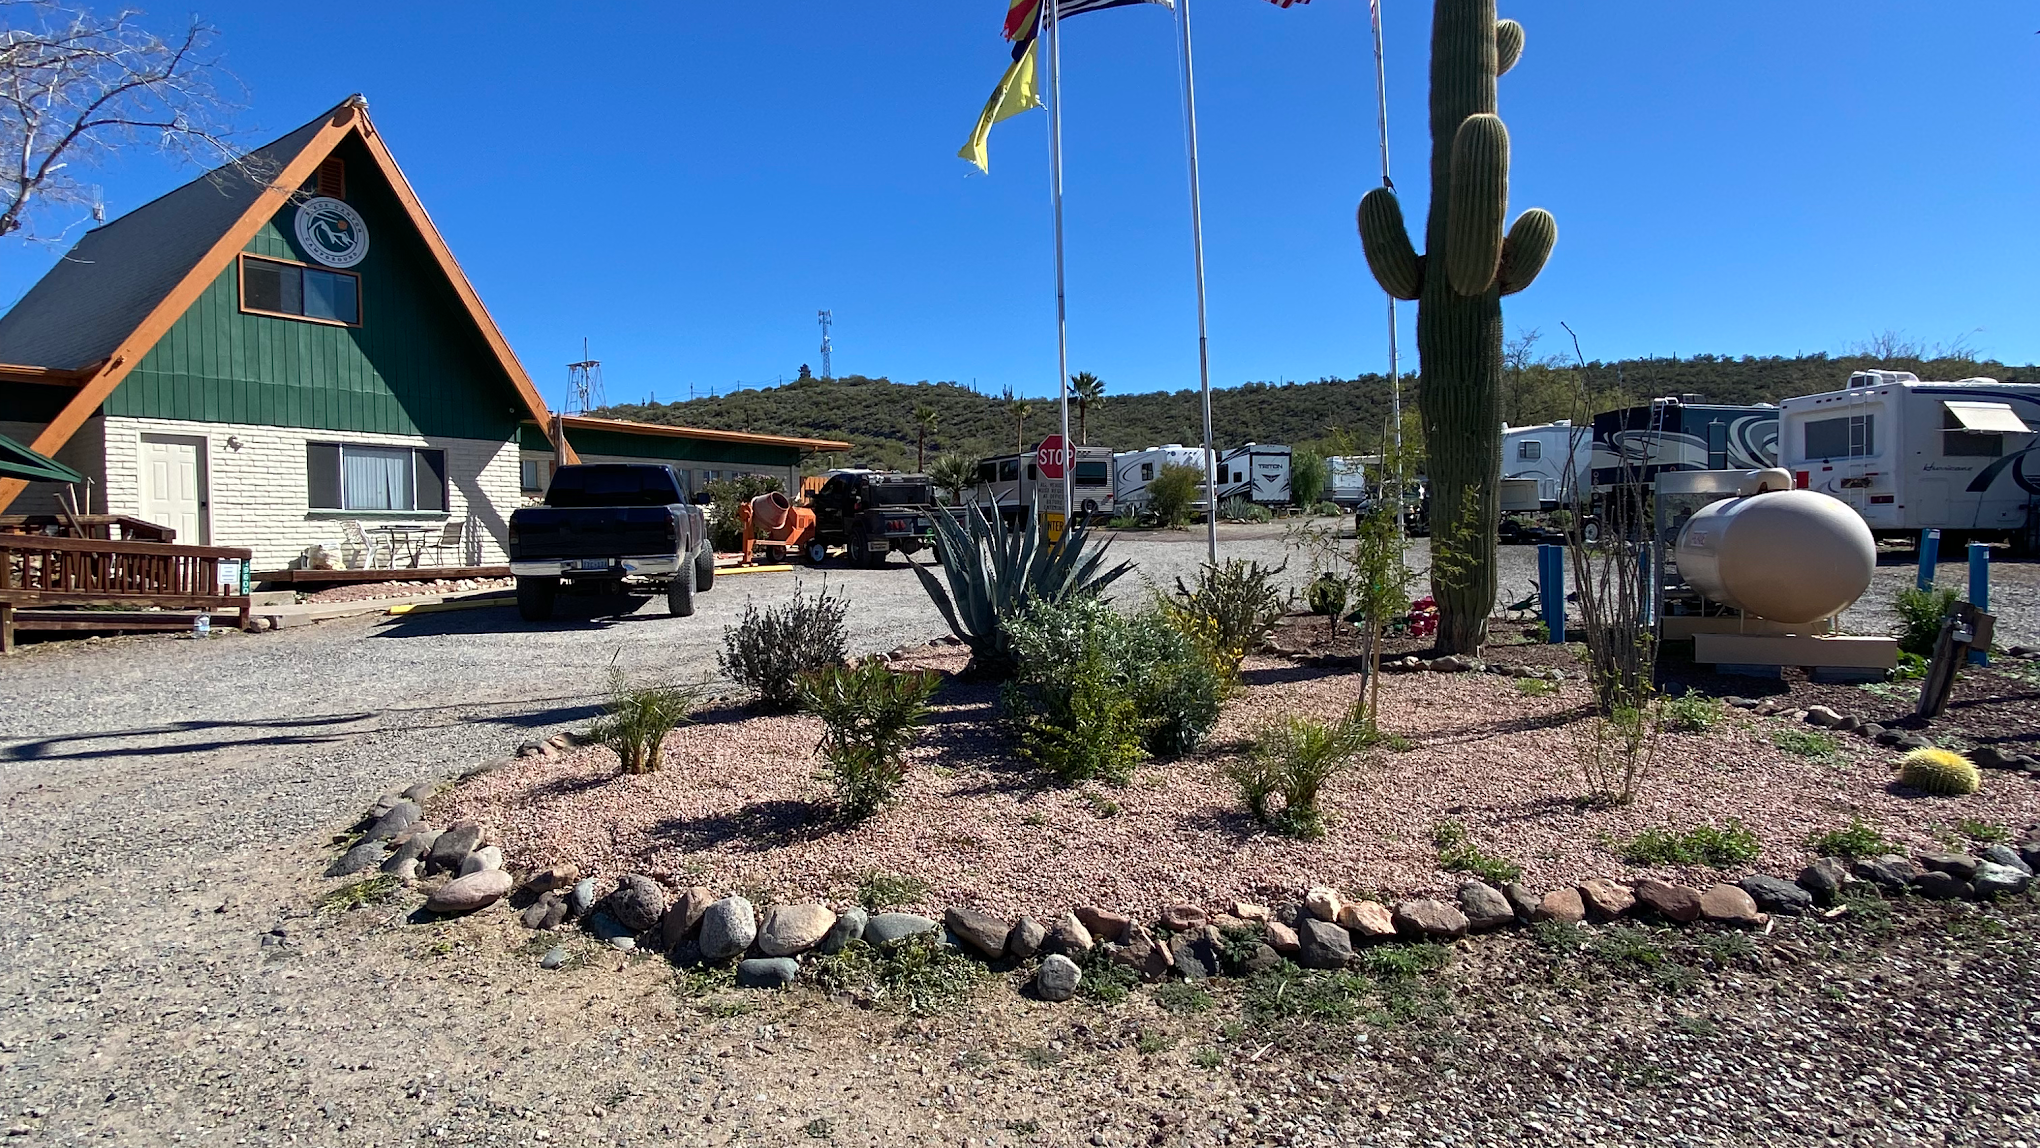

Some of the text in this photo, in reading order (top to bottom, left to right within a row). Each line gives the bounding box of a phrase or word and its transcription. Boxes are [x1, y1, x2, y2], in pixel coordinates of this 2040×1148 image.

[305, 203, 362, 233] BACK CANYON
[305, 237, 357, 262] CAMPGROUND
[1039, 449, 1074, 466] STOP
[1923, 461, 1973, 471] Hurricane
[1048, 520, 1064, 531] NTER
